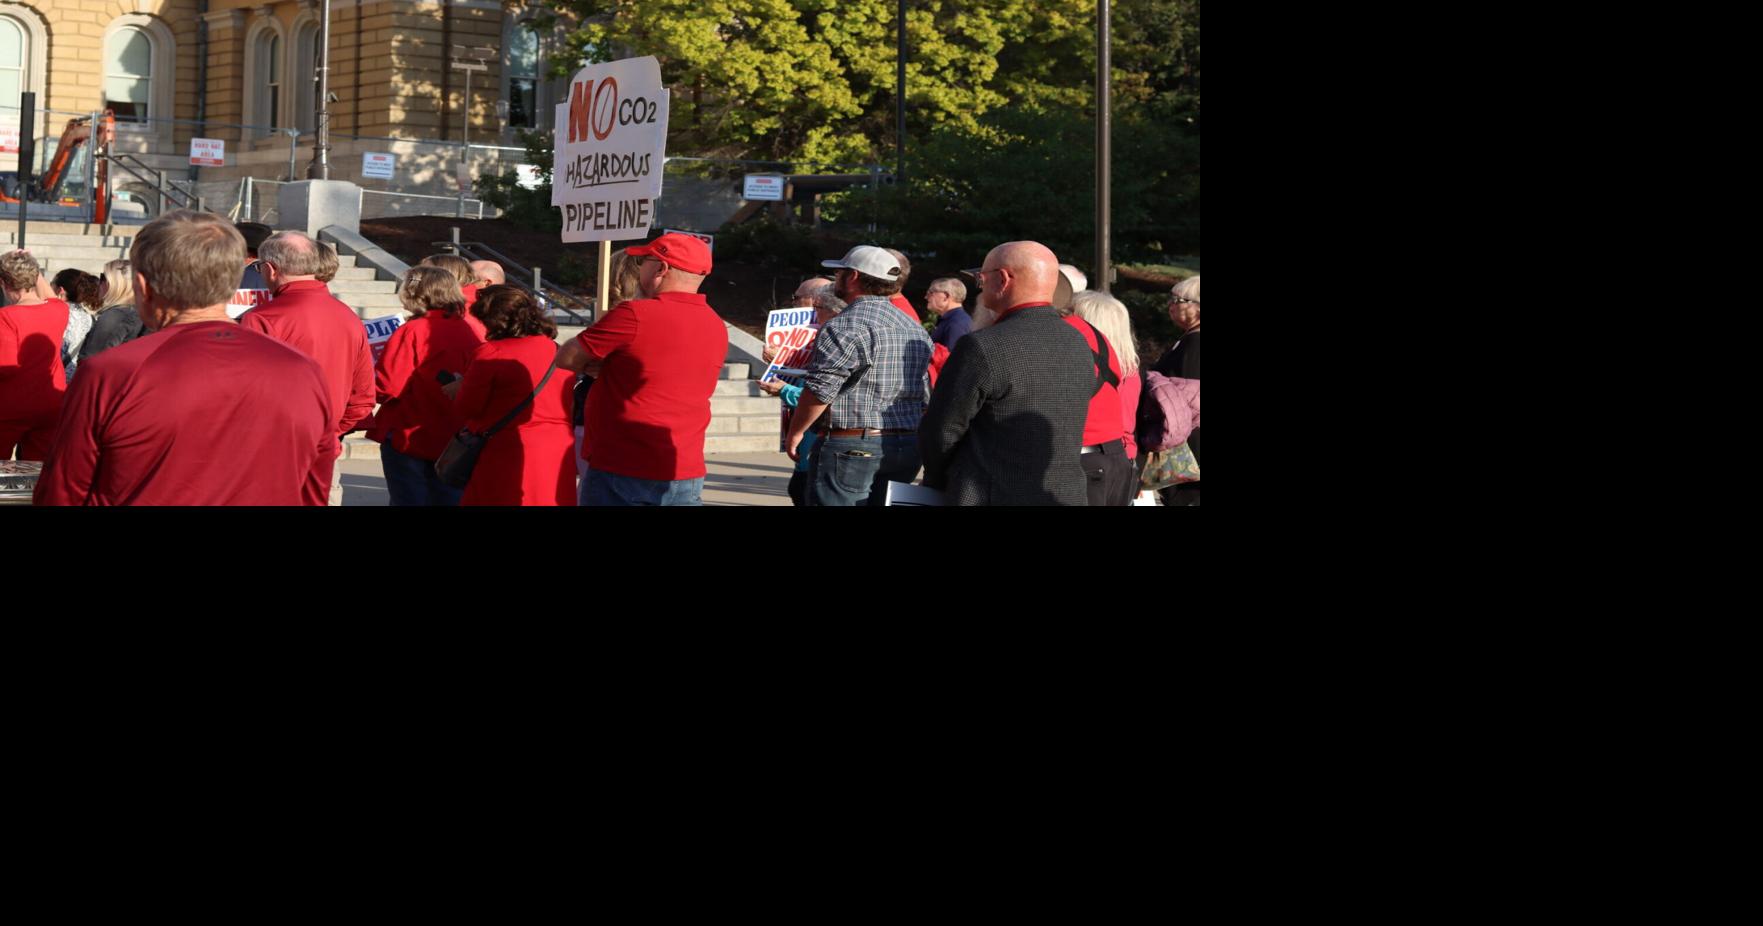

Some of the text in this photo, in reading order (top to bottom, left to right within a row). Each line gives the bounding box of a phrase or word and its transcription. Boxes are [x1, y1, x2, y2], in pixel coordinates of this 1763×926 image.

[569, 76, 657, 143] NO CO2
[566, 152, 651, 189] HAZARDOUS
[566, 199, 649, 232] PIPELINE
[785, 327, 809, 348] NO
